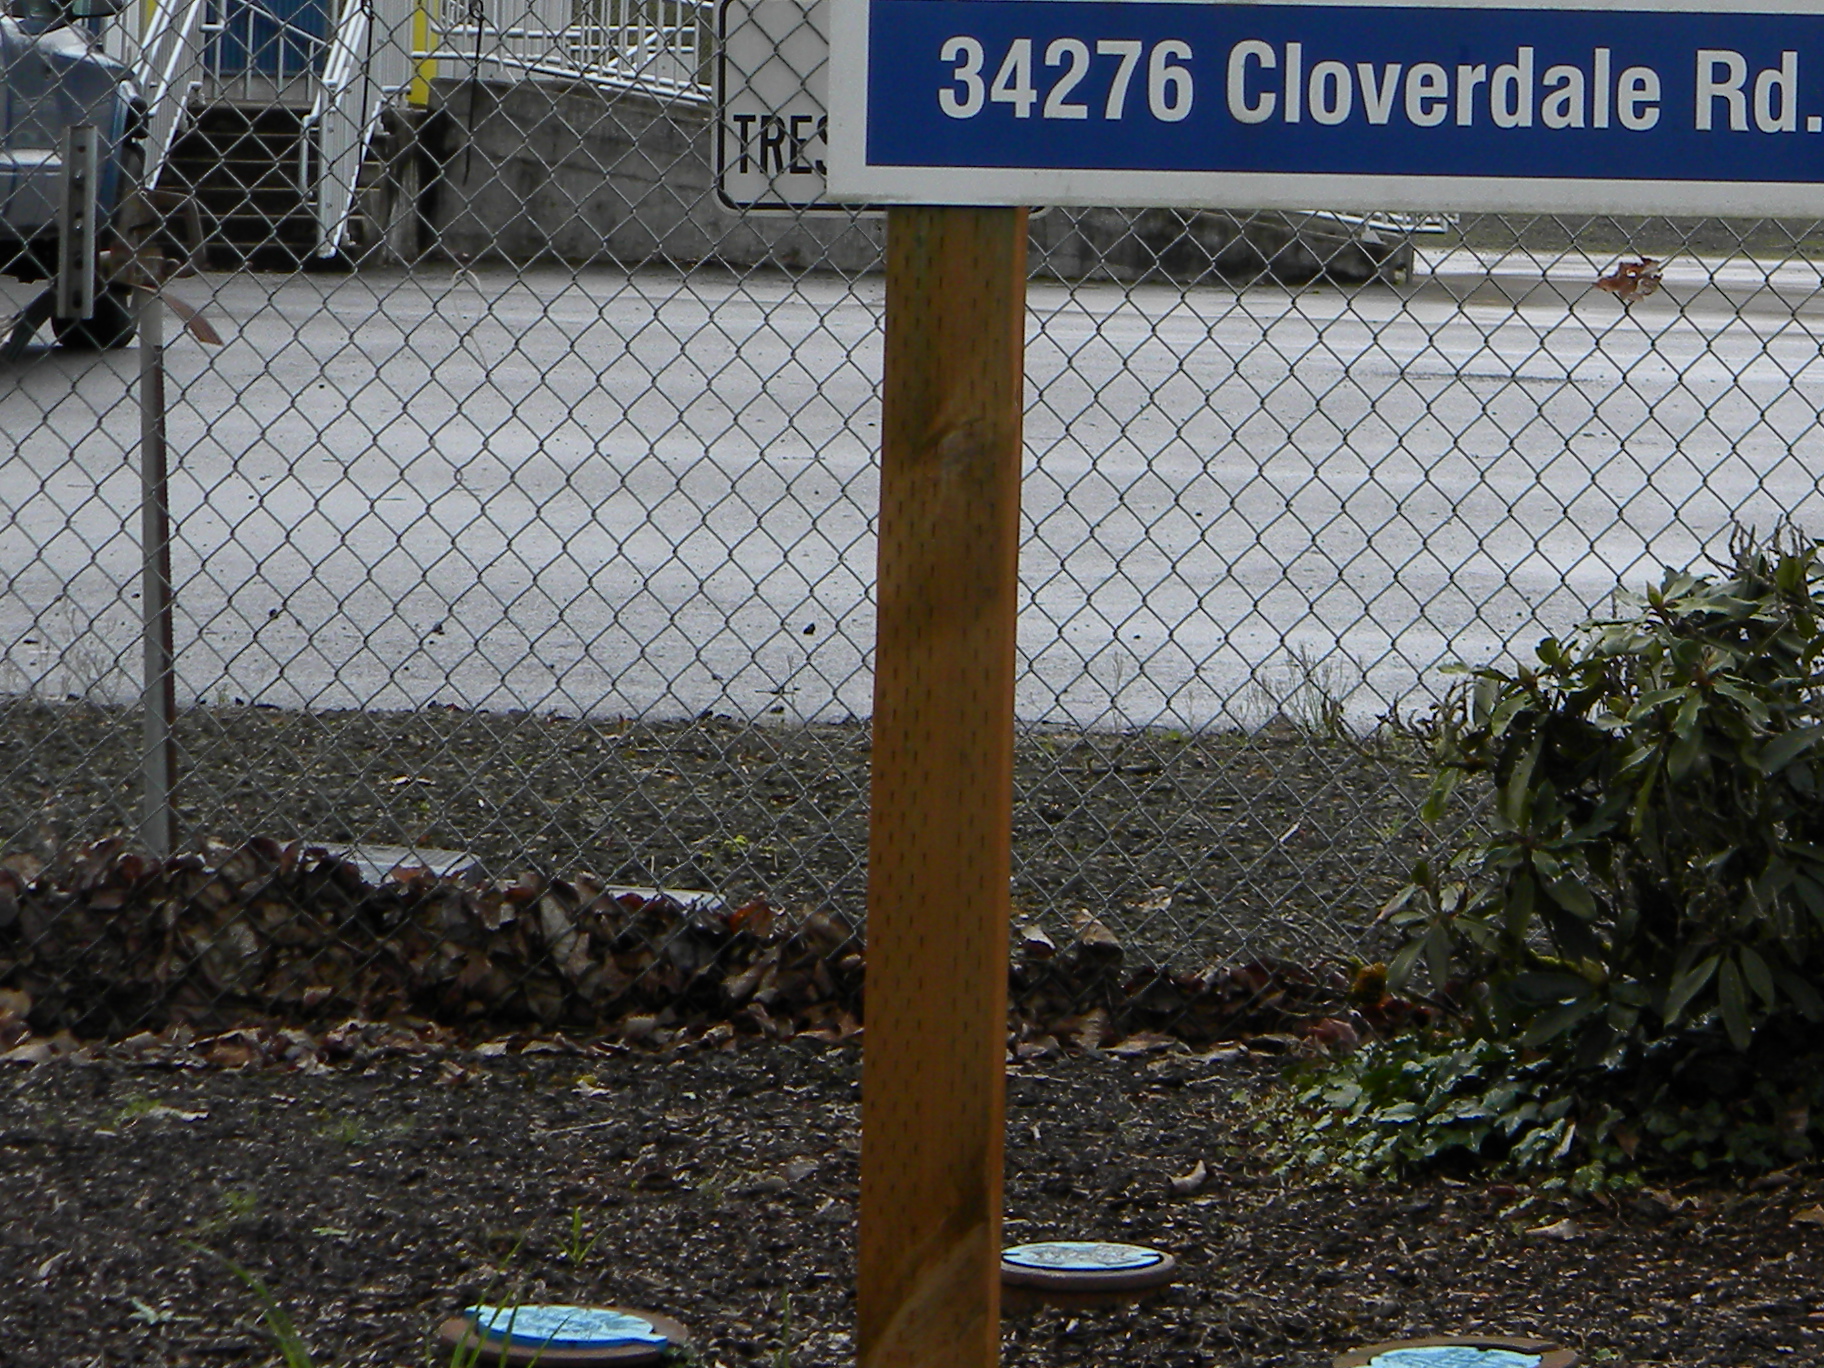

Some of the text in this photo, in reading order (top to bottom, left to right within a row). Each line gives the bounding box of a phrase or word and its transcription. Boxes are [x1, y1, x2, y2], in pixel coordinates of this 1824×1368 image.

[938, 36, 1194, 122] 34276
[1226, 40, 1662, 130] Cloverdale
[1695, 49, 1823, 134] Rd.
